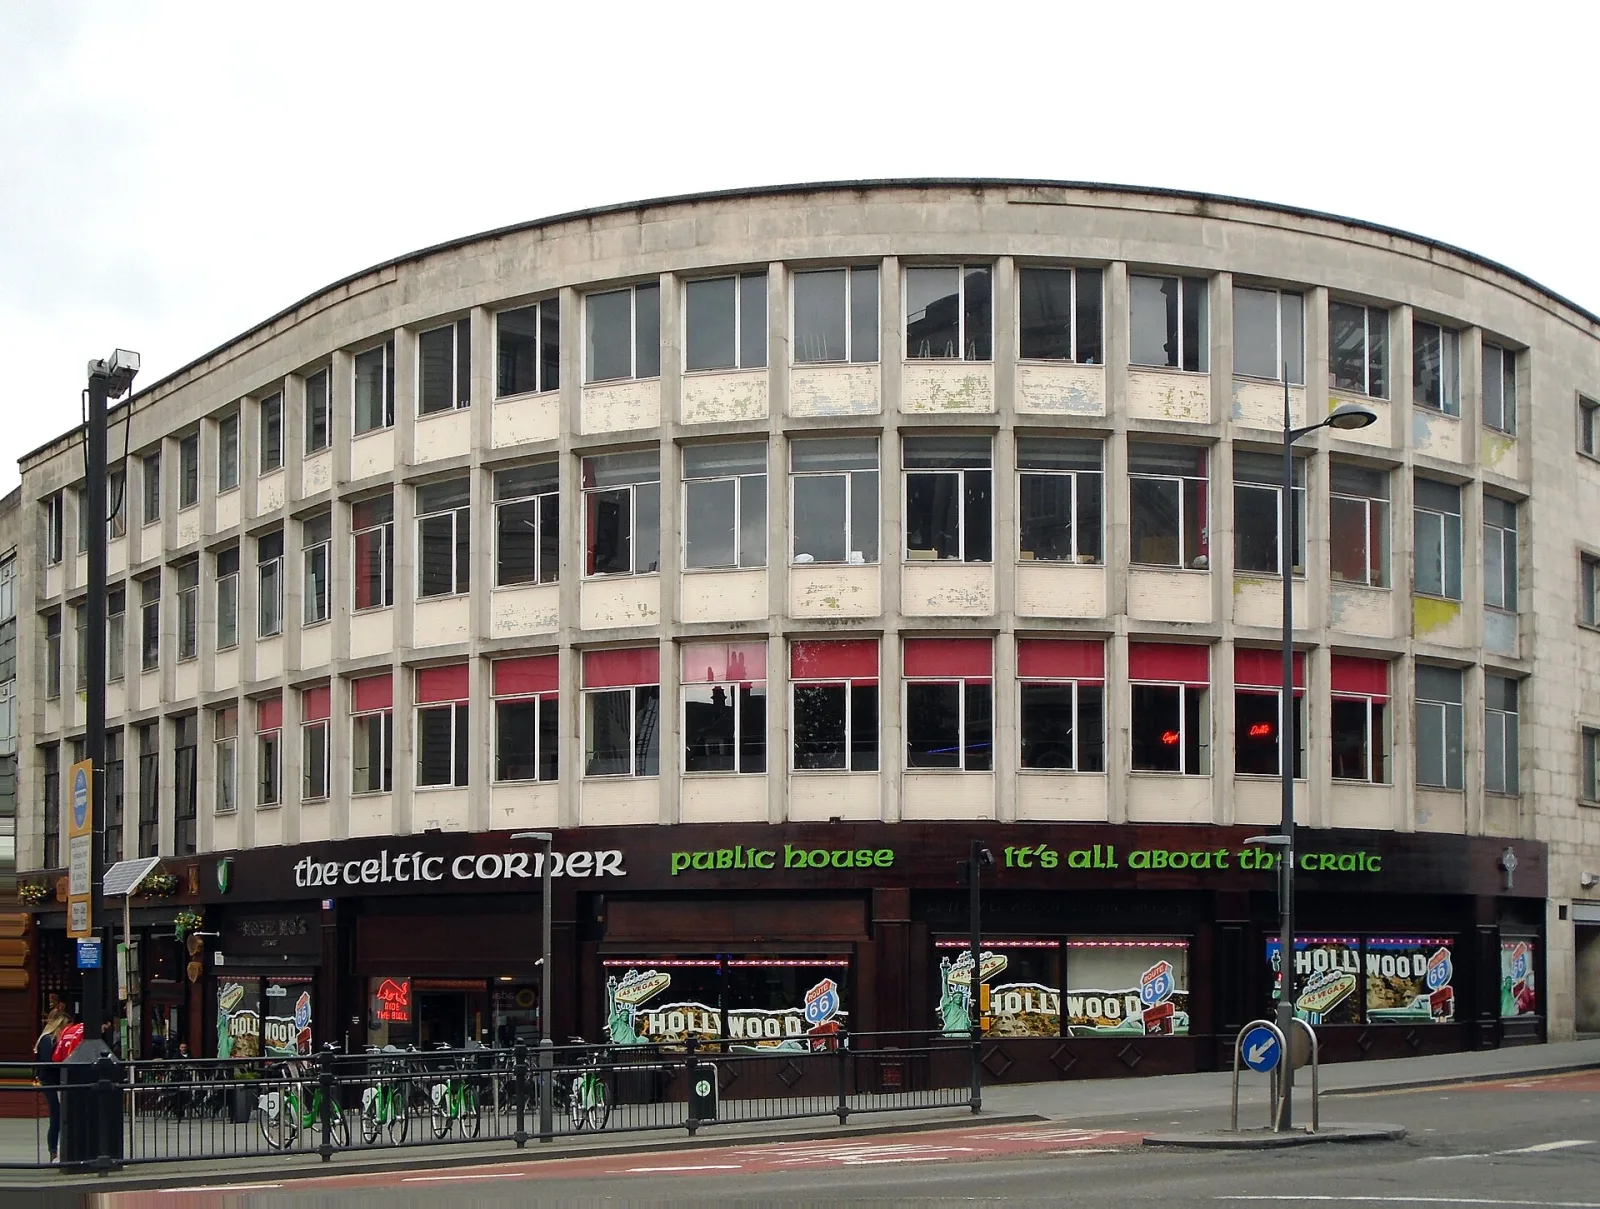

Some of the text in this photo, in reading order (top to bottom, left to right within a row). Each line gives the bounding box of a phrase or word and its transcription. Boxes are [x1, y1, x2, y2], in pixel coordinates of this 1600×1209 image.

[293, 855, 339, 888] the
[451, 850, 627, 880] corner
[671, 844, 895, 876] public house
[1068, 844, 1118, 869] all
[1127, 847, 1231, 870] about
[1238, 847, 1283, 870] th
[1300, 851, 1382, 872] craic
[1430, 964, 1446, 984] 66
[632, 978, 660, 993] VEGAS
[1144, 977, 1165, 999] 66
[1317, 982, 1346, 999] VEGAS
[809, 995, 830, 1018] 66
